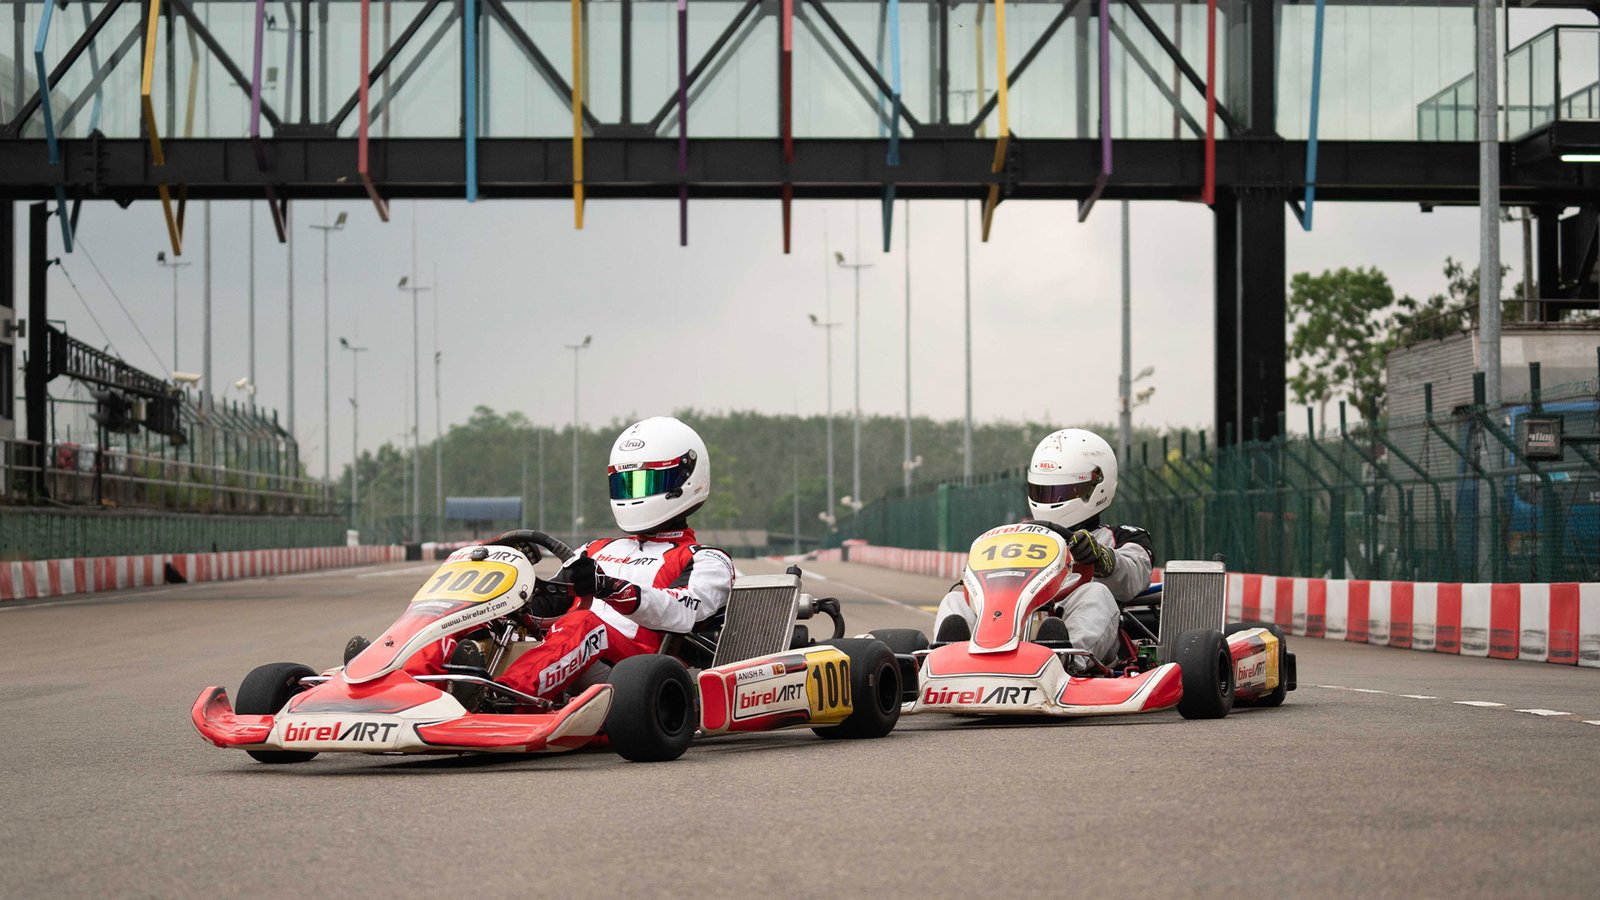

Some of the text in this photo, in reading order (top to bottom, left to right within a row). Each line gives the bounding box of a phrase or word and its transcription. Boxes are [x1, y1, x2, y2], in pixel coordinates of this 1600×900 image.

[624, 440, 642, 448] Arai
[981, 525, 1050, 538] birelART
[597, 553, 658, 565] birelART
[981, 543, 1048, 560] 165
[427, 569, 505, 594] 100
[441, 600, 508, 629] www.birelart.com
[545, 629, 605, 687] birelART
[738, 668, 765, 681] ANISH R.
[812, 659, 849, 711] 100
[740, 684, 803, 709] birelART
[924, 686, 1038, 705] birelART
[284, 721, 399, 742] birelART
